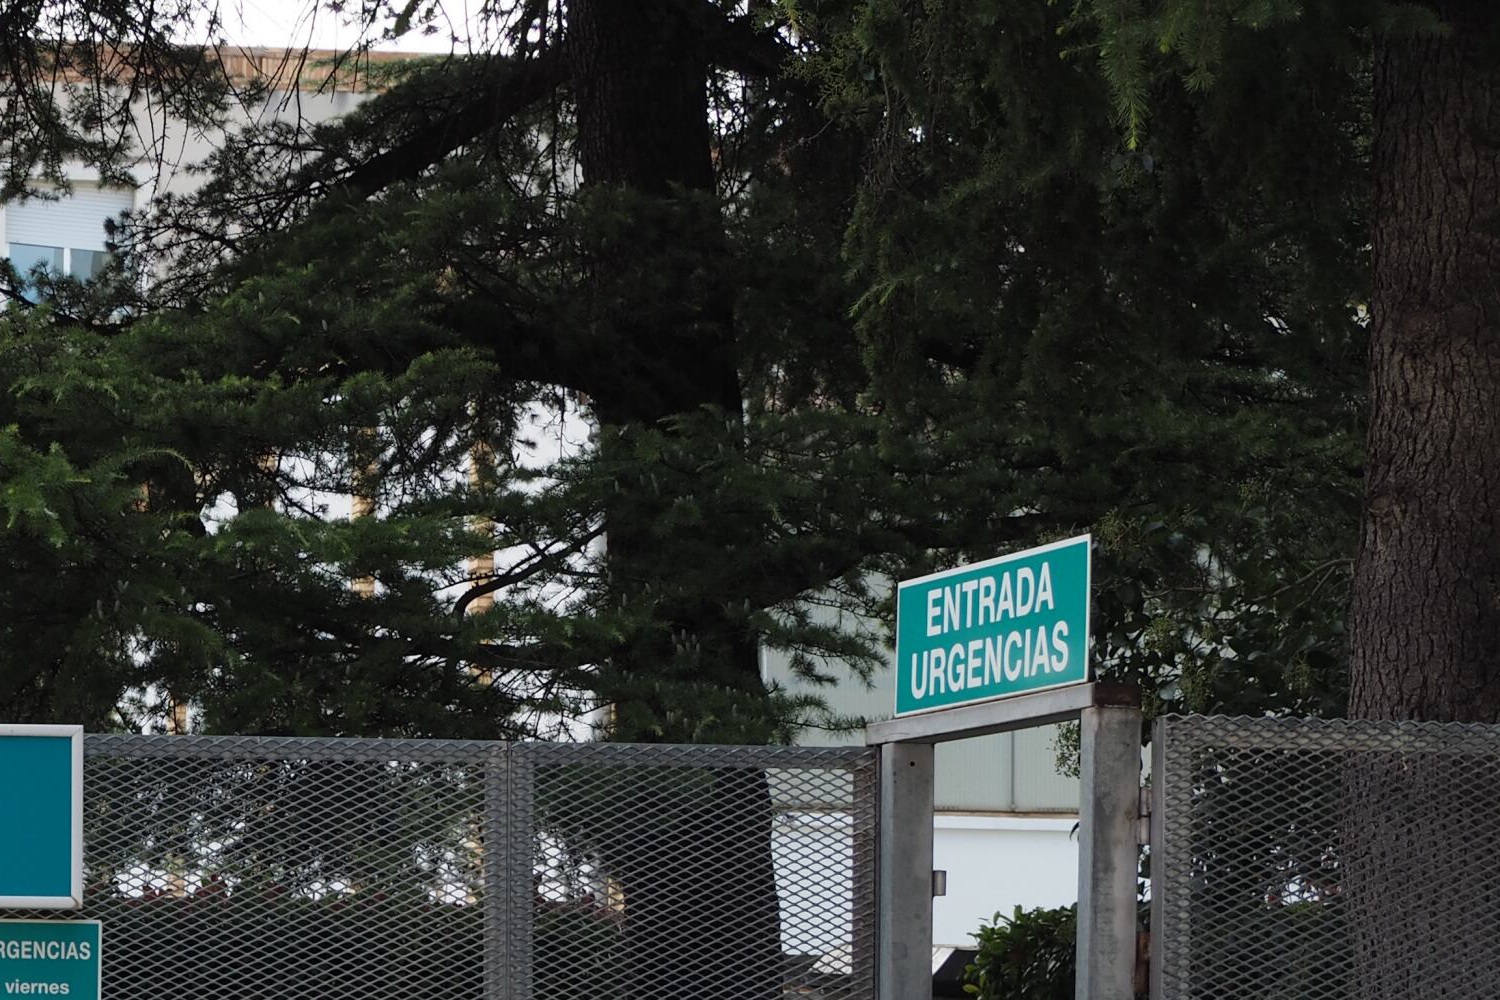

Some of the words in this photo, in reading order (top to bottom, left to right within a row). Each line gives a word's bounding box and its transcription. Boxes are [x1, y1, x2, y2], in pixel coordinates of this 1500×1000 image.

[926, 561, 1054, 637] ENTRADA
[910, 620, 1068, 699] URGENCIAS
[5, 979, 70, 995] viernes
